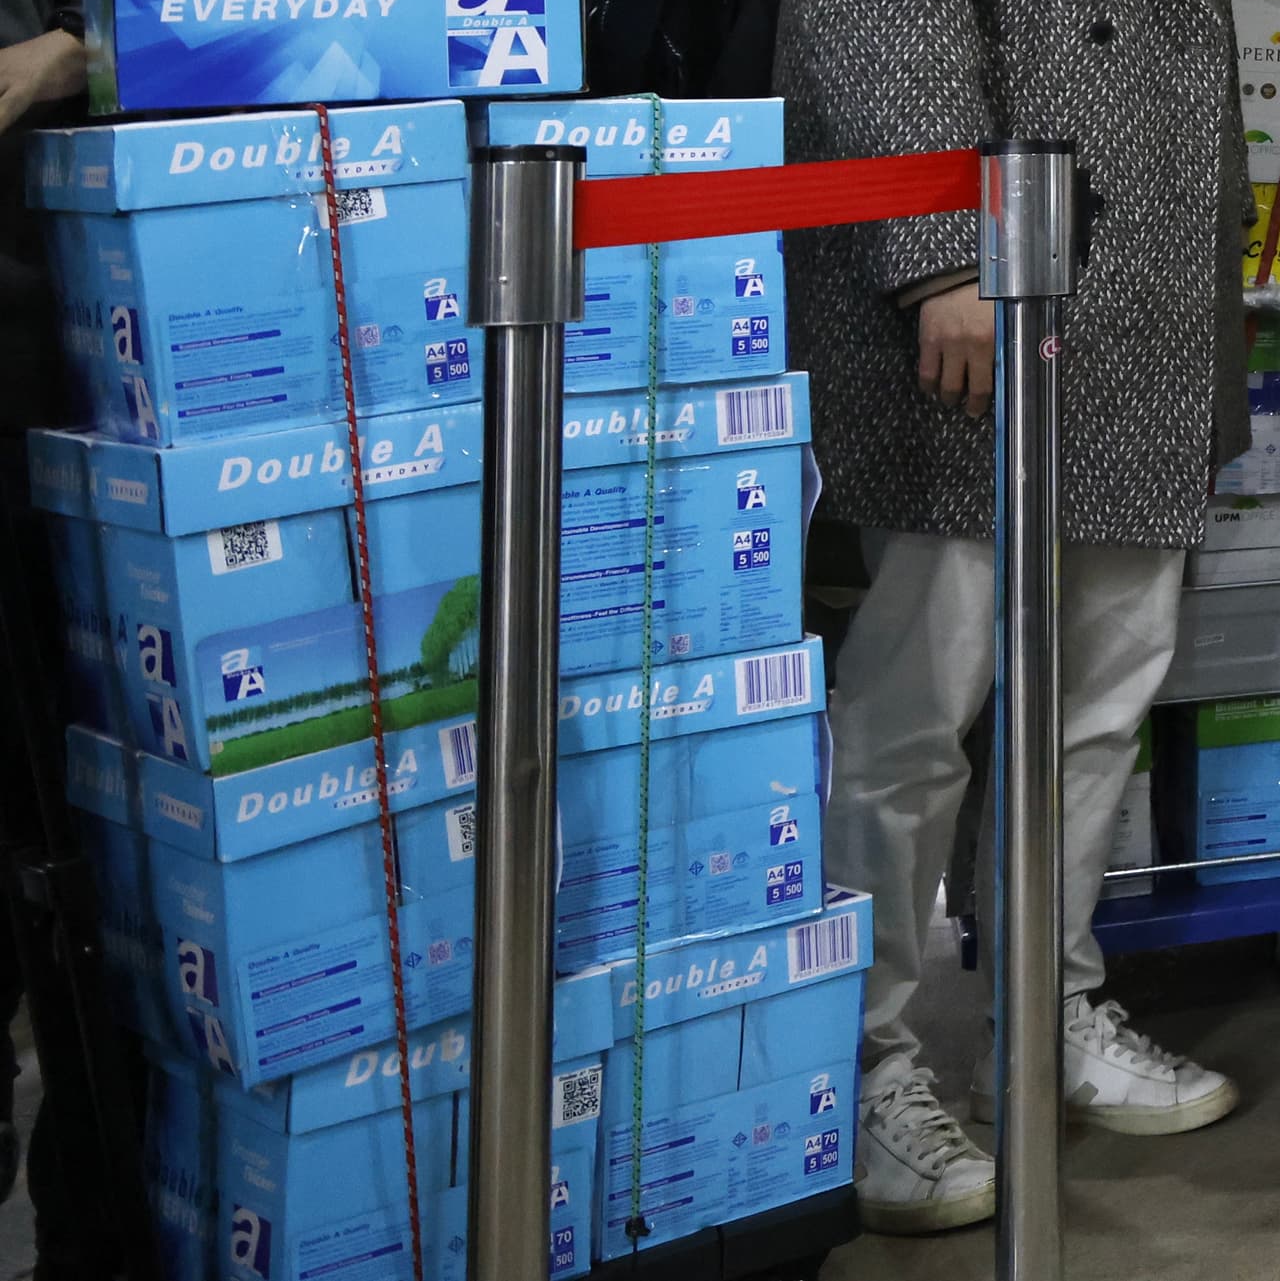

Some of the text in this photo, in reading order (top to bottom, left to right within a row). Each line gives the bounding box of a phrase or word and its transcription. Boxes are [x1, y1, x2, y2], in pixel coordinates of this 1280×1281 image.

[464, 17, 513, 27] Double
[372, 125, 402, 156] A
[705, 117, 731, 143] A
[732, 318, 768, 332] A4 70
[427, 342, 466, 360] A4 70
[738, 337, 769, 351] 5 500
[433, 361, 469, 378] 5 500
[674, 403, 696, 426] A
[414, 424, 444, 456] A
[693, 673, 715, 699] A
[395, 748, 418, 776] A
[748, 944, 768, 970] A
